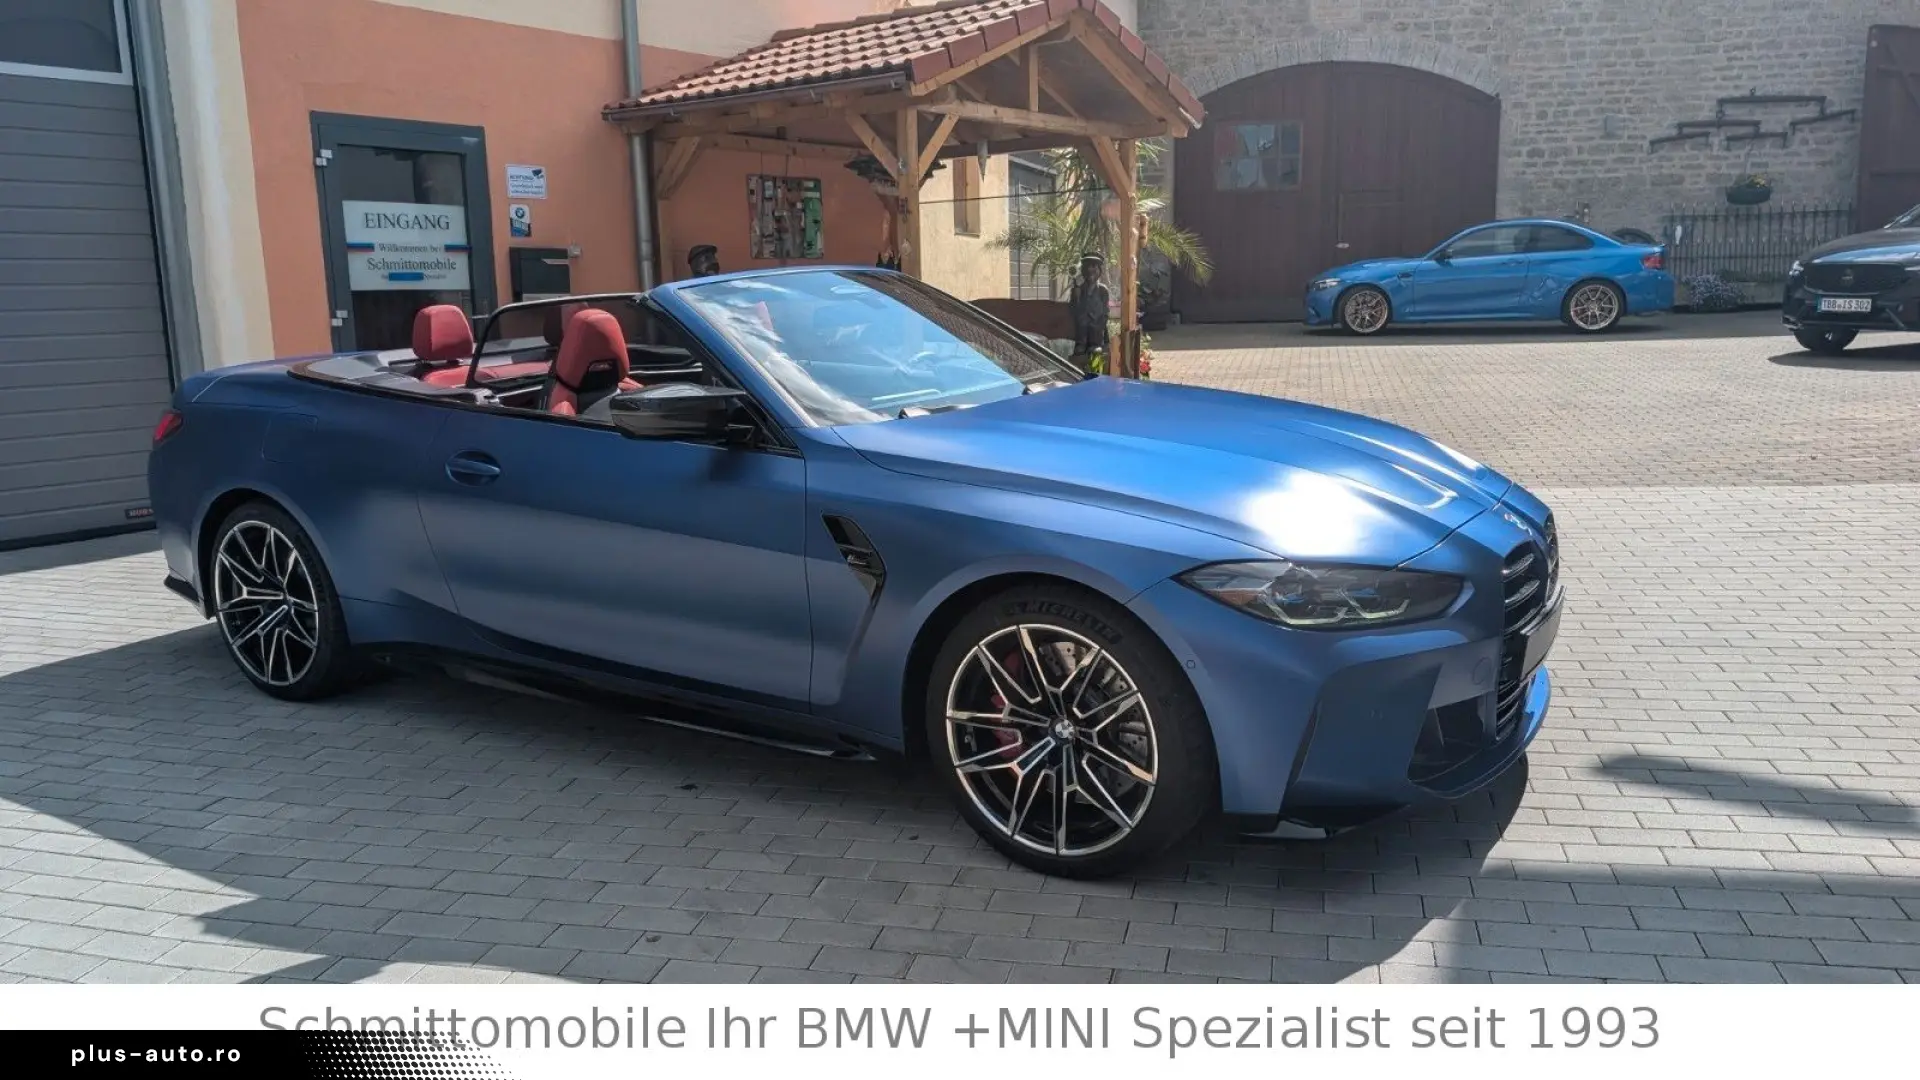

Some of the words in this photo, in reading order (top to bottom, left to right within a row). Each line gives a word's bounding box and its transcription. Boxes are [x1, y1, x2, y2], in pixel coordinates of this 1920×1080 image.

[364, 212, 450, 230] EINGANG
[378, 243, 428, 253] Willkommen
[367, 257, 457, 270] Schmittomobile
